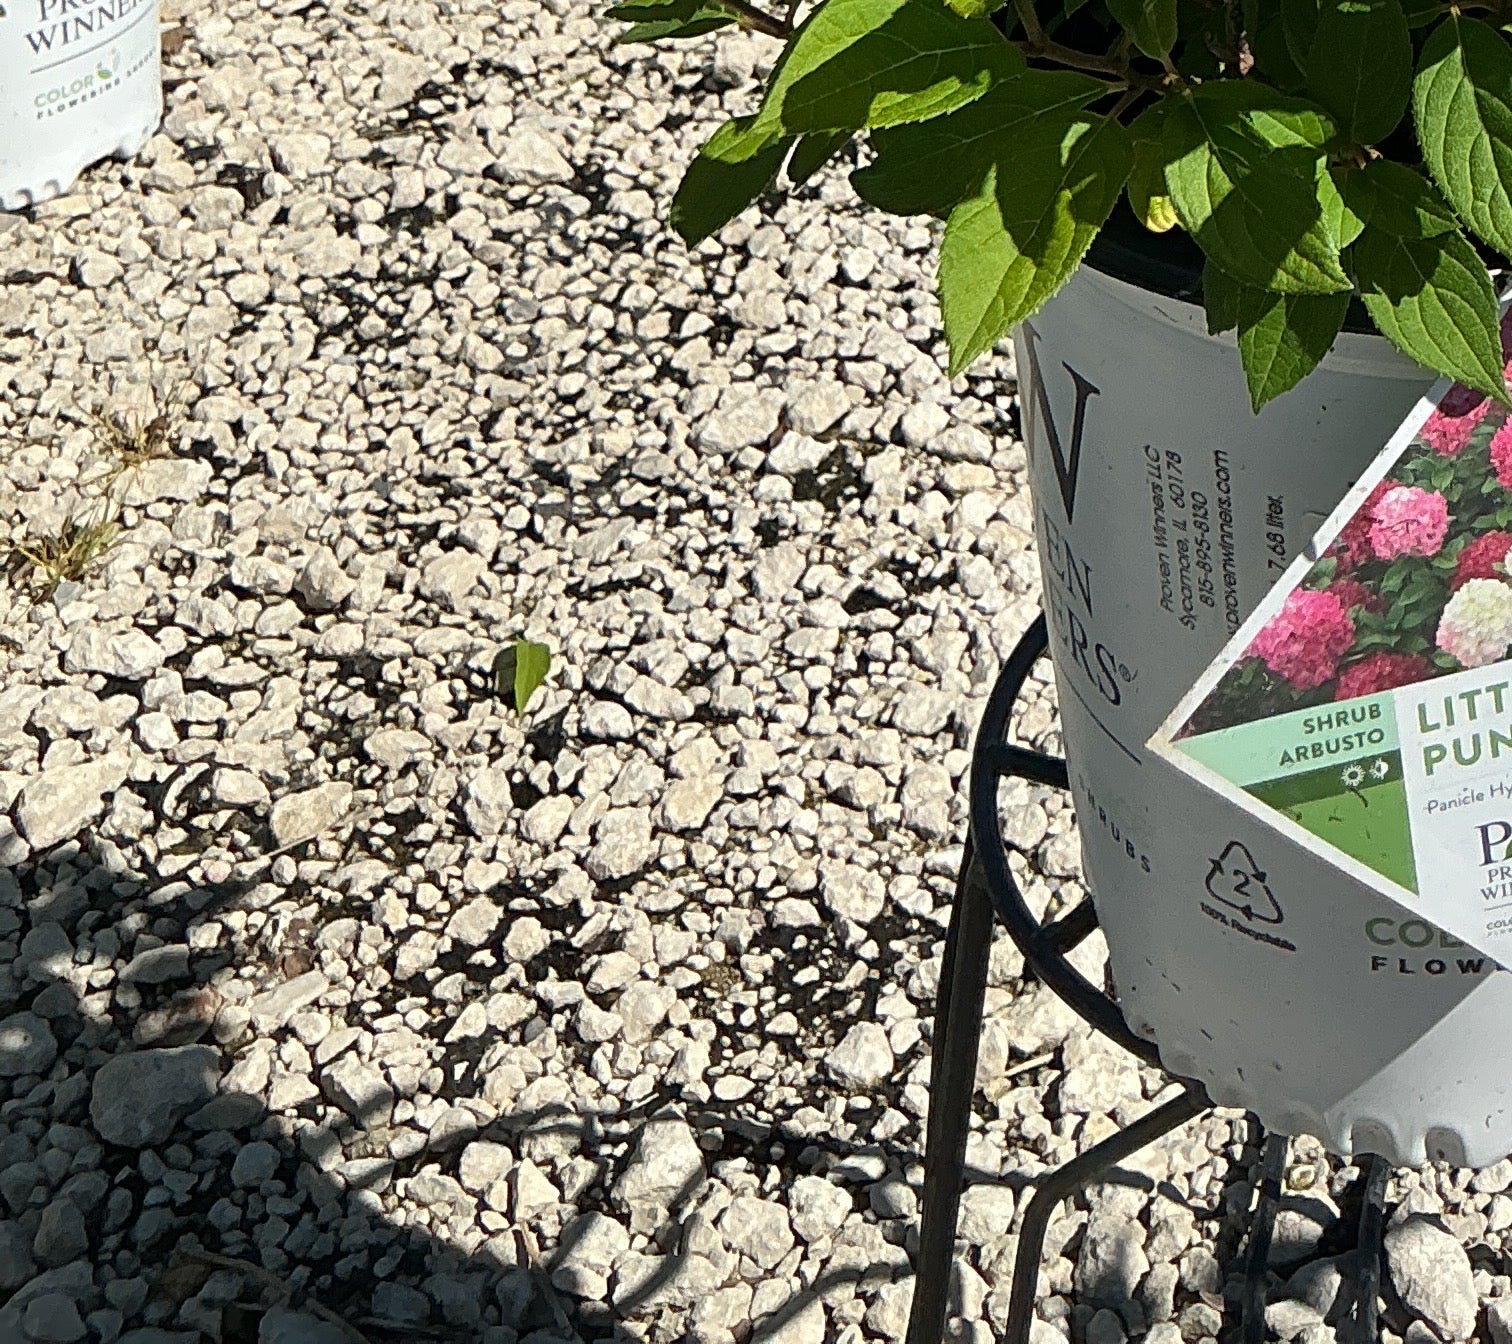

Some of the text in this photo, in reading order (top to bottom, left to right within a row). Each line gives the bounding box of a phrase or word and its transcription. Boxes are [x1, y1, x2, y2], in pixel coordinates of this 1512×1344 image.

[34, 74, 94, 108] COLOR
[1166, 450, 1186, 510] 60178
[1143, 444, 1174, 612] Proven Winners LLC
[1173, 518, 1188, 533] IL
[1190, 491, 1215, 608] 815-895-8130
[1265, 531, 1287, 572] 7.68
[1303, 703, 1381, 734] SHRUB
[1279, 728, 1385, 766] ARBUSTO
[1426, 787, 1485, 814] Panicle
[1233, 869, 1251, 897] 2
